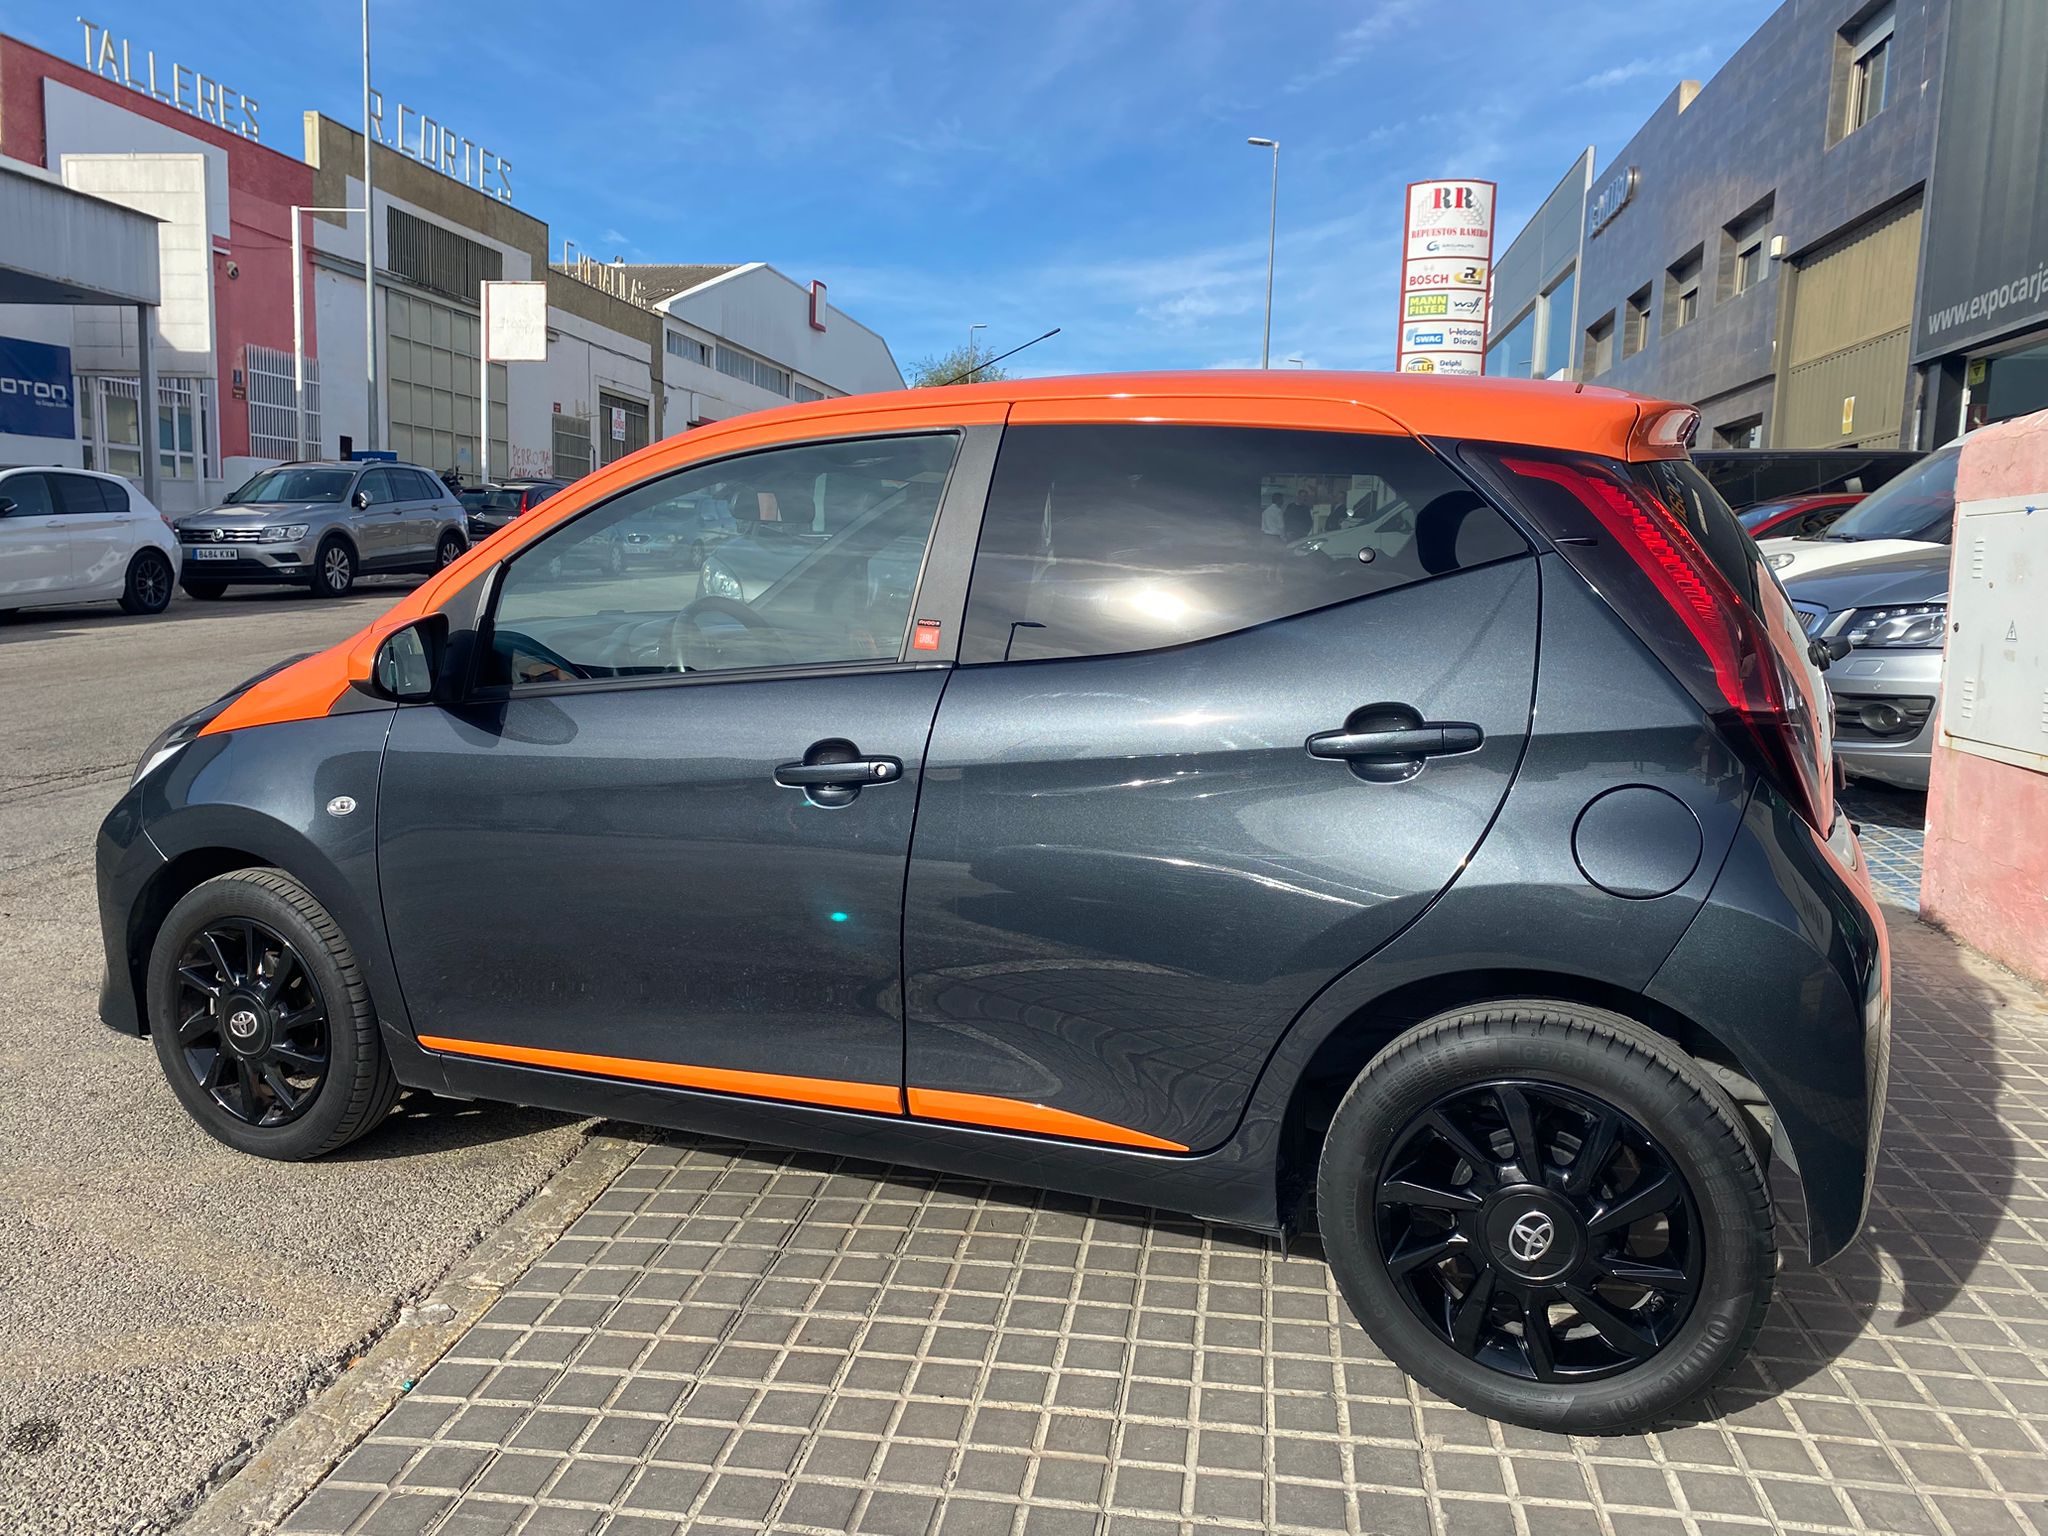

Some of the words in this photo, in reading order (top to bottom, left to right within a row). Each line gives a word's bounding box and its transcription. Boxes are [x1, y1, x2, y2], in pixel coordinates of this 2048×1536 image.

[76, 16, 259, 142] TALLERES
[1411, 228, 1457, 239] REPUESTOS
[1460, 228, 1489, 238] RAMIRO
[1409, 274, 1450, 287] BOSCH
[1410, 295, 1448, 306] MANN
[1409, 305, 1447, 315] FILTER
[1415, 335, 1443, 344] SWAG
[1453, 337, 1478, 346] Diavia
[1407, 363, 1434, 373] HELLA
[198, 550, 218, 559] 8484
[919, 633, 935, 644] JBL
